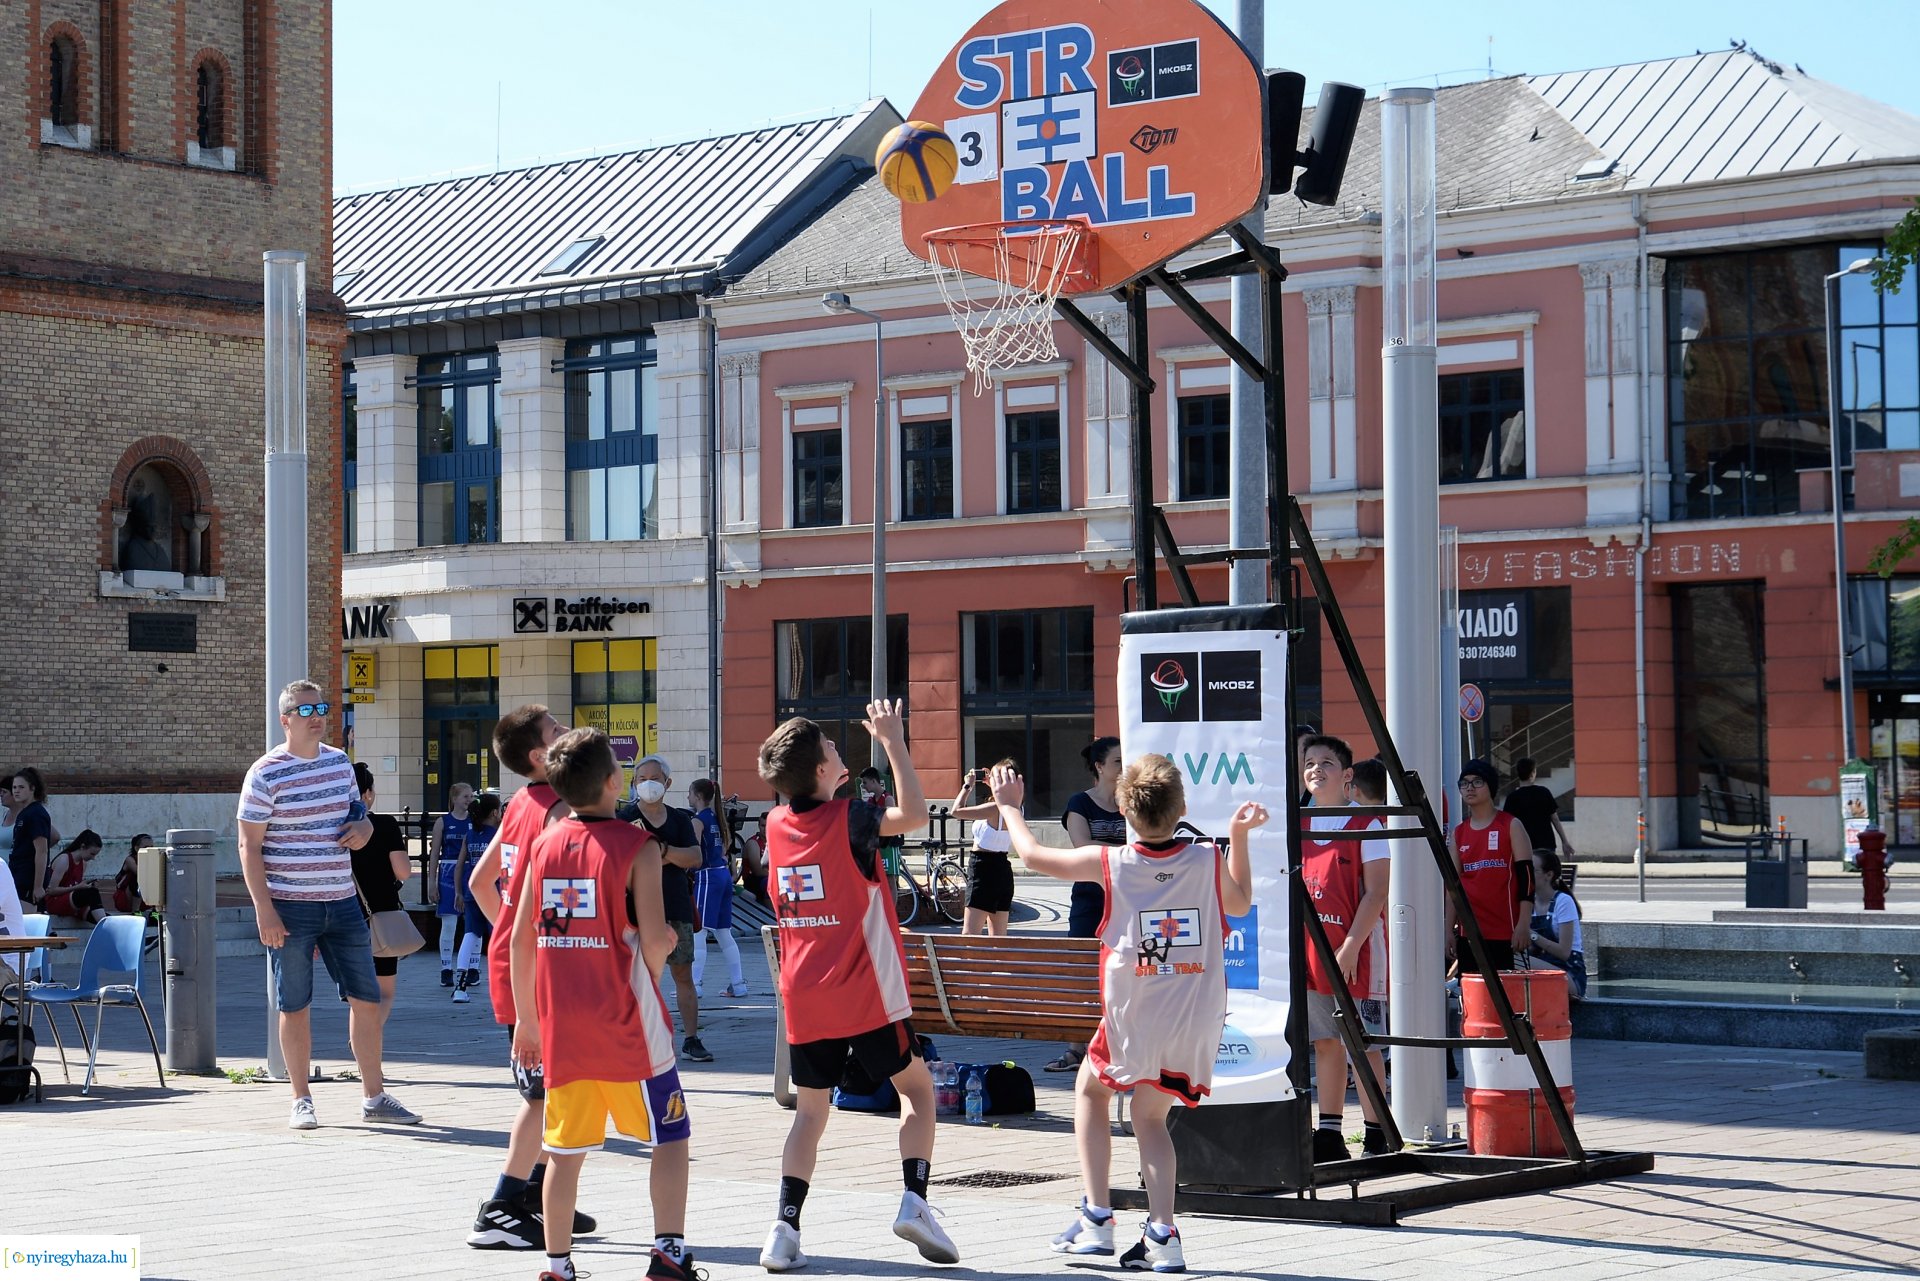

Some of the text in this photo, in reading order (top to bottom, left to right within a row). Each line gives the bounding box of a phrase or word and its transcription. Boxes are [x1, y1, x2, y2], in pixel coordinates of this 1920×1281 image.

[954, 23, 1097, 109] STR
[1159, 64, 1193, 75] MKOSZ
[959, 131, 983, 167] 3
[1001, 152, 1195, 236] BALL
[554, 596, 650, 615] Raiffeisen
[555, 615, 615, 632] BANK
[1208, 681, 1255, 690] MKOSZ
[537, 936, 609, 948] STREETBALL
